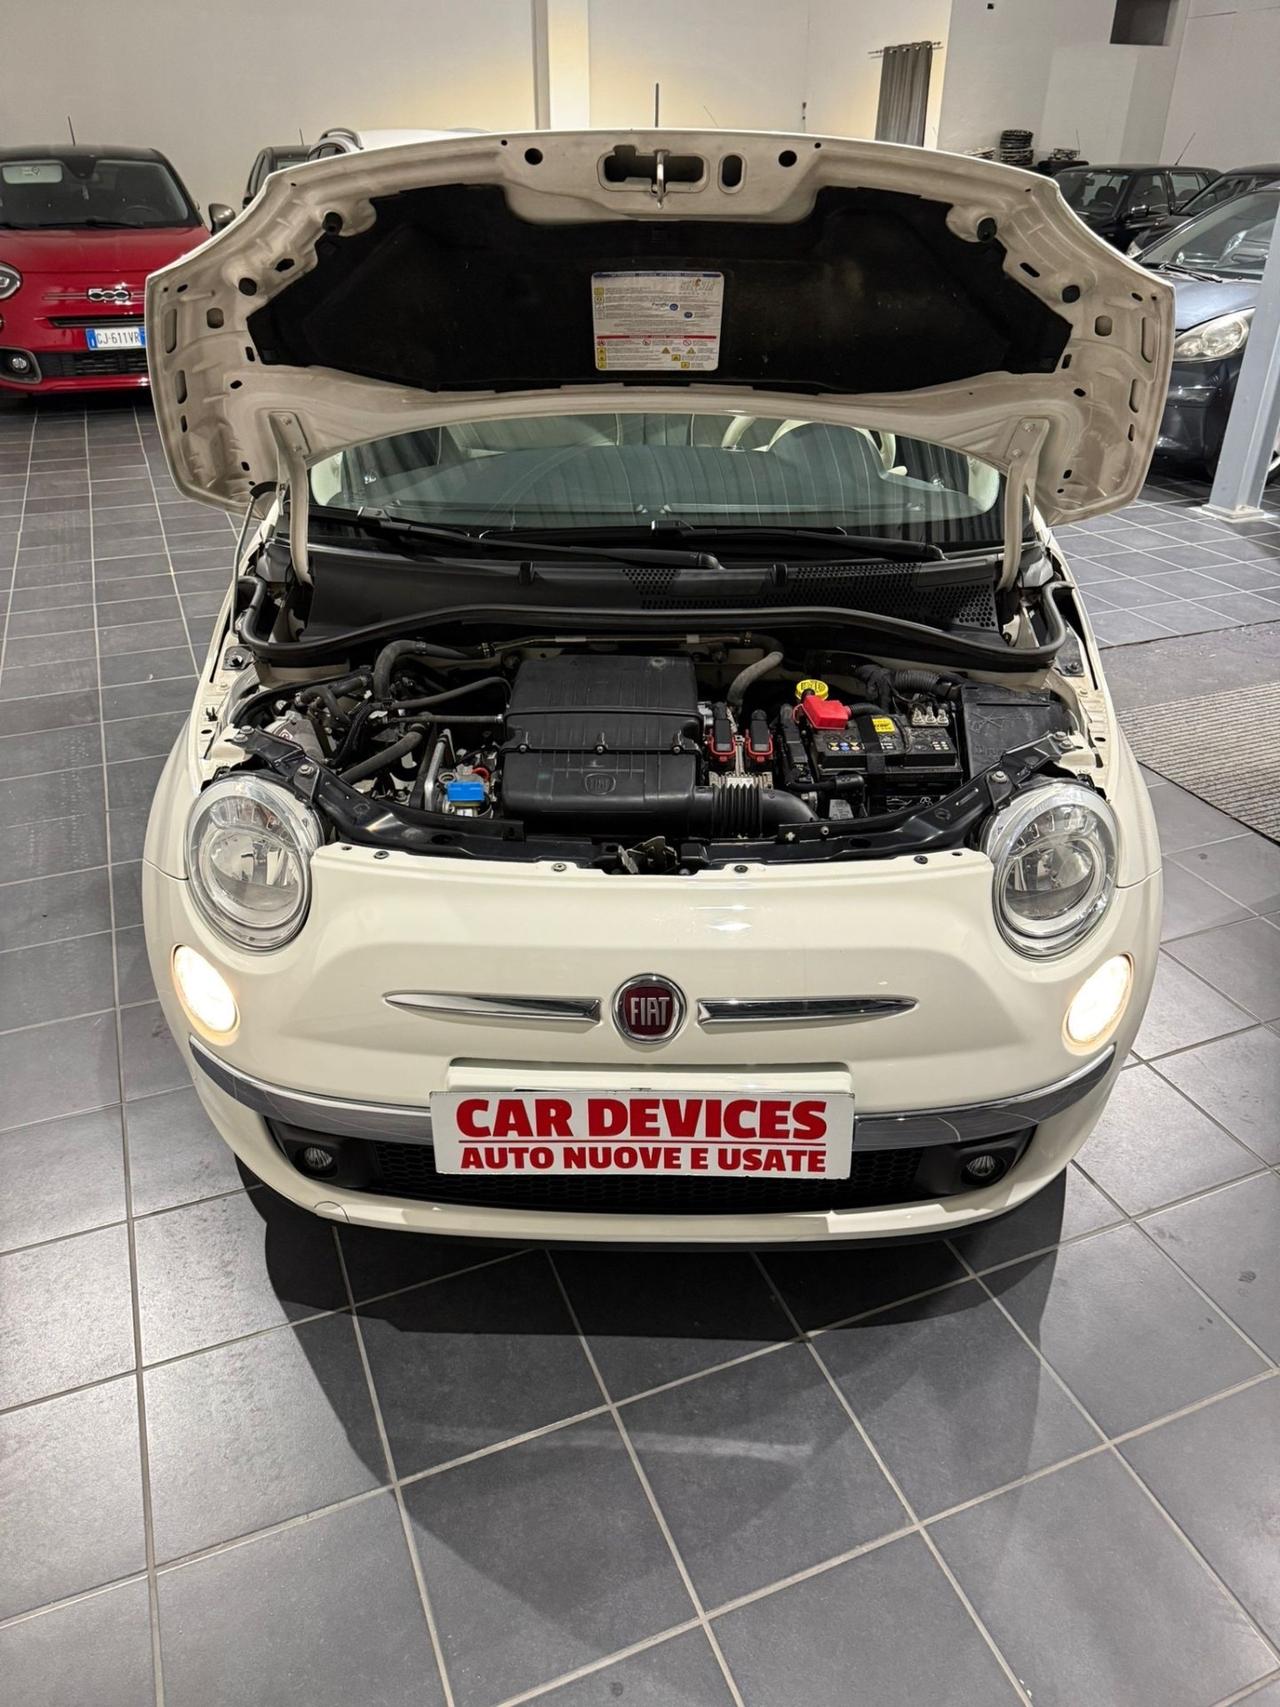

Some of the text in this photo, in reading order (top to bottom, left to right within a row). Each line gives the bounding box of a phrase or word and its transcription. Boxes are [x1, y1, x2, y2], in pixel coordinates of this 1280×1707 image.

[88, 288, 130, 301] 500
[630, 997, 670, 1025] FIAT
[456, 1098, 828, 1140] CAR DEVICES
[461, 1146, 827, 1173] AUTO NUOVE E USATE
